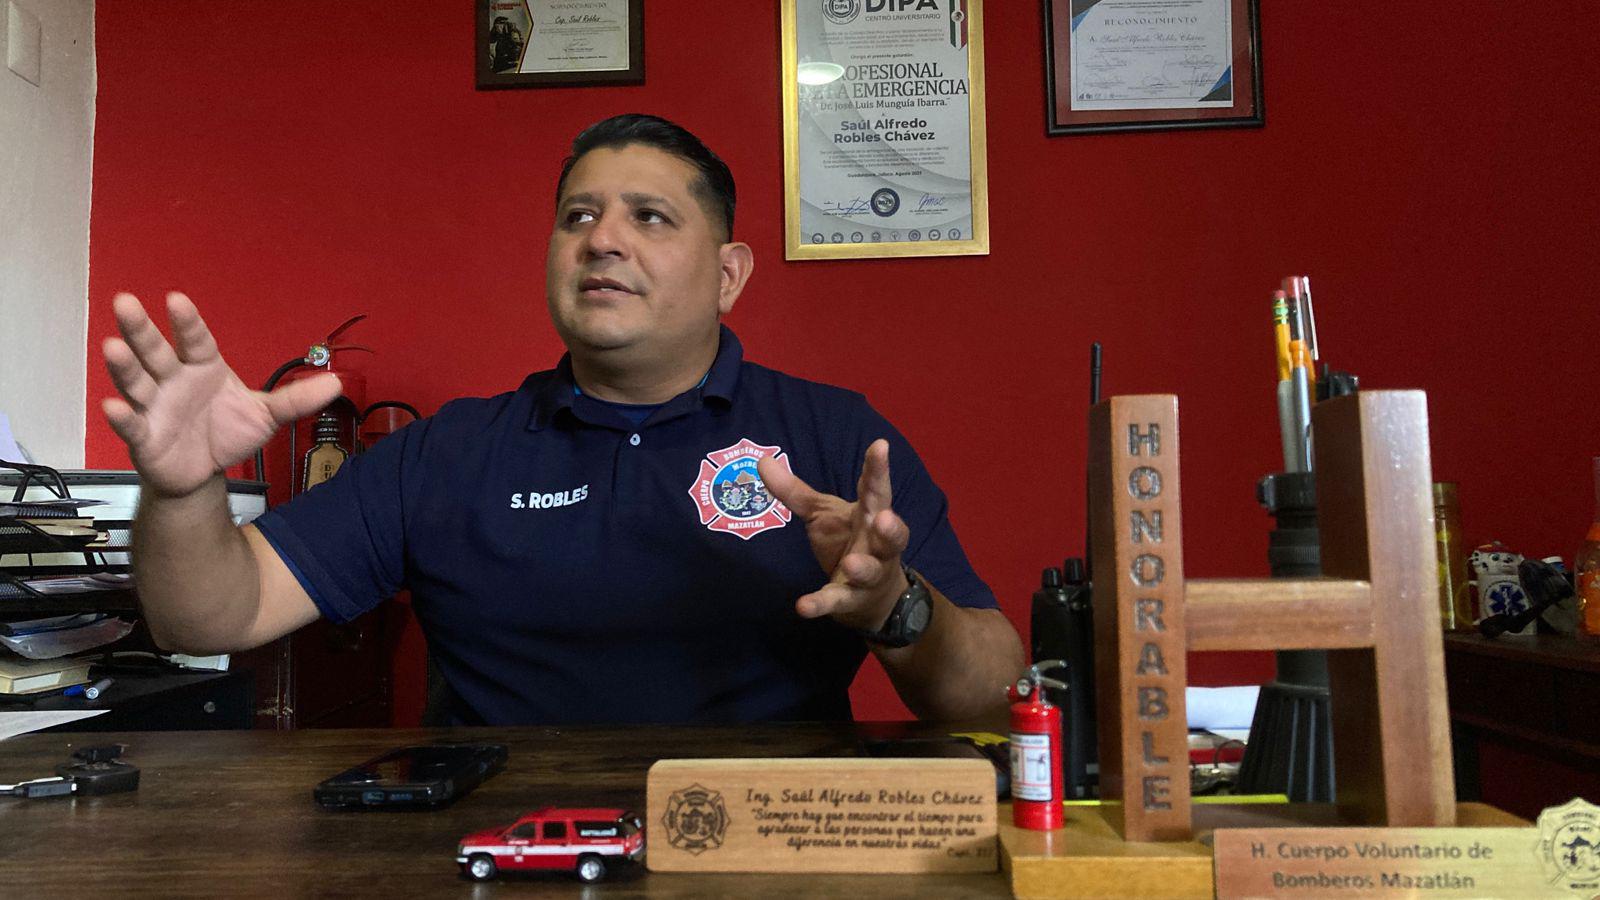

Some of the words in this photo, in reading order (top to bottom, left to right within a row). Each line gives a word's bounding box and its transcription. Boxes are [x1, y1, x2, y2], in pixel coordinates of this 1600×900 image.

[892, 13, 941, 21] UNIVERSITARIO
[841, 62, 943, 81] OFESIONAL
[853, 79, 968, 98] EMERGENCIA
[820, 103, 833, 111] Dr.
[855, 100, 874, 109] Luis
[876, 98, 915, 110] Munguía
[841, 118, 871, 131] Saúl
[874, 118, 927, 130] Alfredo
[834, 132, 881, 144] Robles
[885, 129, 935, 142] Chávez
[510, 493, 525, 509] S.
[529, 484, 589, 509] ROBLES
[1127, 422, 1173, 812] HONORABLE
[781, 789, 814, 803] Saúl
[819, 789, 872, 807] Alfredo
[878, 789, 925, 804] Robles
[932, 791, 983, 805] Chávez
[802, 809, 822, 824] hay
[825, 812, 844, 825] que
[847, 811, 900, 822] encontrar
[918, 812, 954, 824] tiempo
[957, 813, 983, 825] para
[757, 823, 811, 837] agradecer
[824, 824, 841, 834] las
[843, 826, 893, 837] personas
[896, 827, 915, 839] que
[919, 824, 952, 836] hacen
[955, 827, 976, 836] una
[787, 836, 842, 851] diferencia
[845, 839, 858, 847] en
[861, 839, 908, 849] nuestras
[1251, 842, 1272, 858] H.
[1277, 842, 1349, 862] Cuerpo
[1354, 842, 1463, 859] Voluntario
[1467, 842, 1494, 859] de
[1272, 870, 1374, 888] Bomberos
[1381, 870, 1475, 889] Mazatlán
